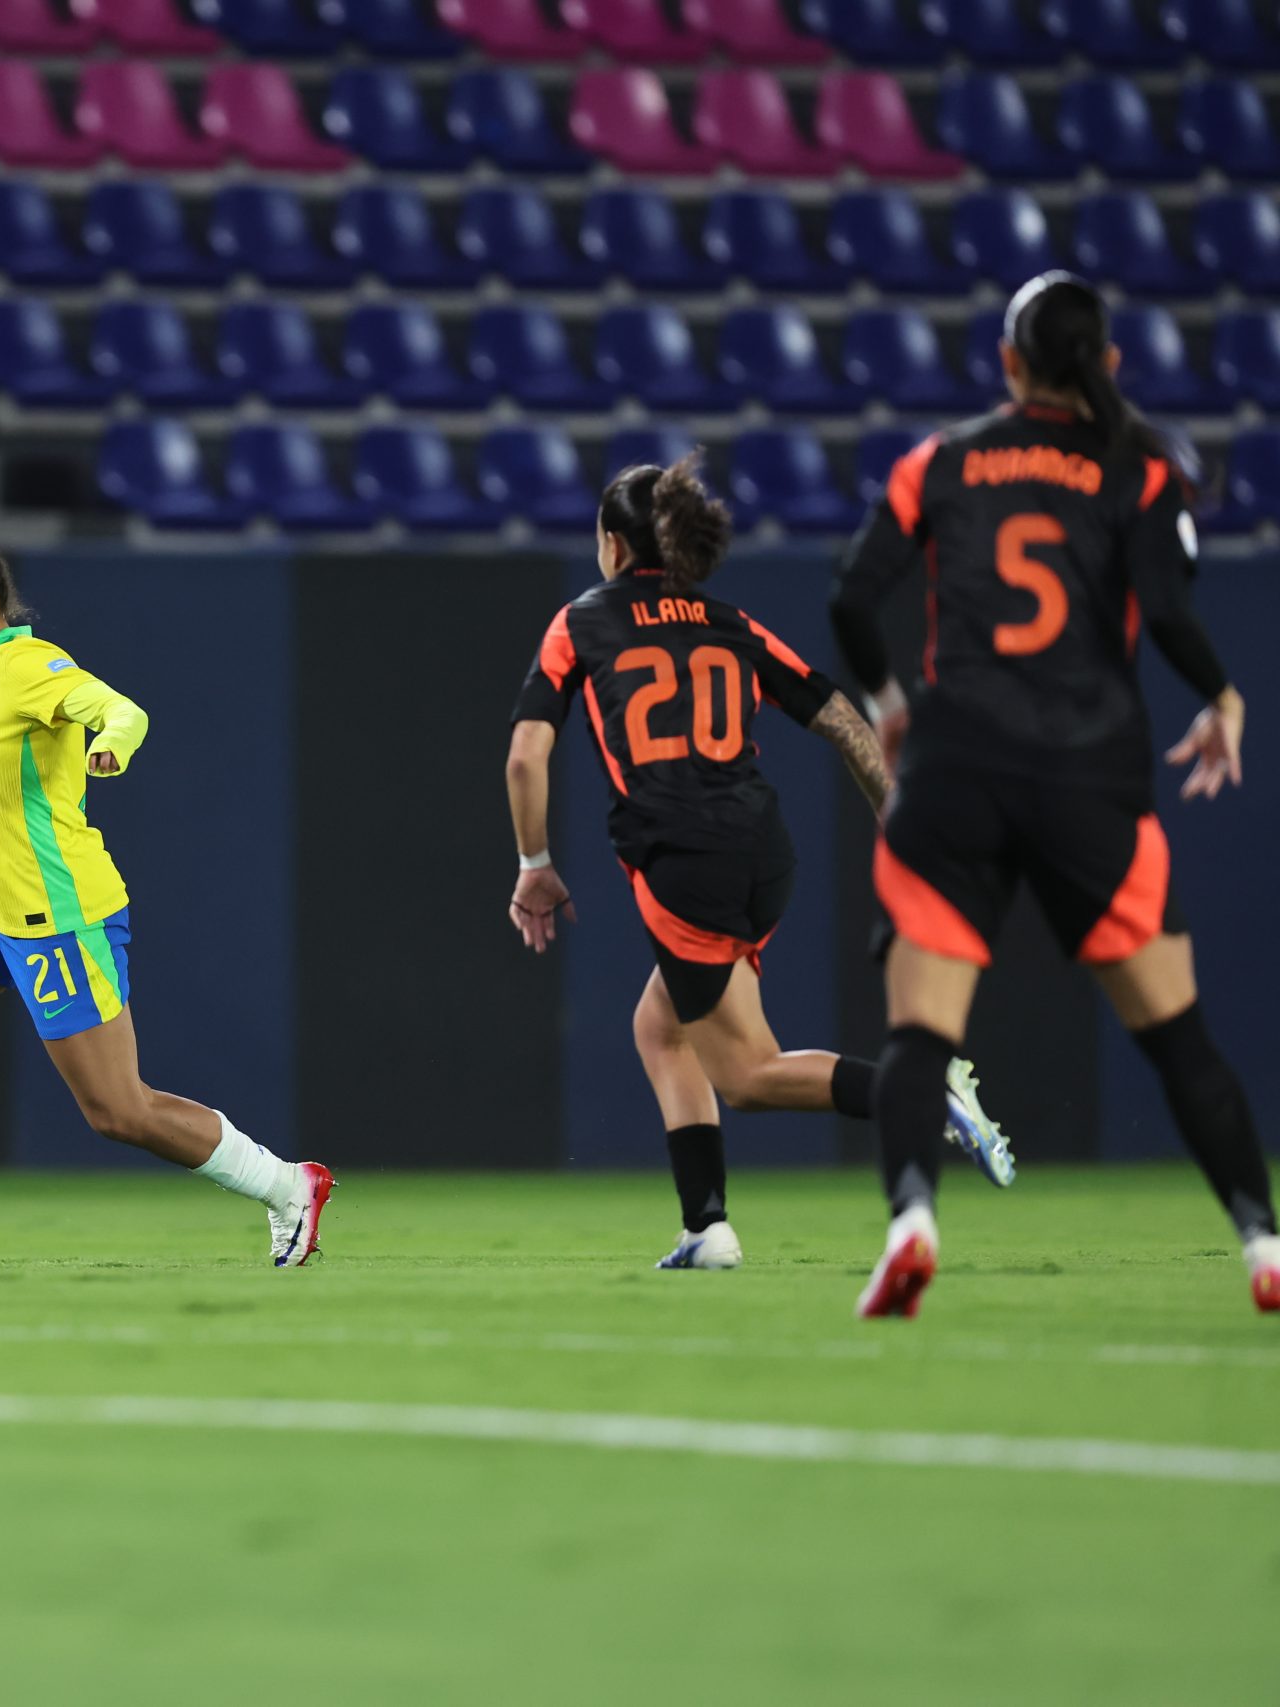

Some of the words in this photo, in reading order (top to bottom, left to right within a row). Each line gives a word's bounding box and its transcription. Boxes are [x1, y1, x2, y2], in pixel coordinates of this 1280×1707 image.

[993, 512, 1068, 656] 5
[614, 645, 743, 766] 20
[26, 947, 77, 1003] 21
